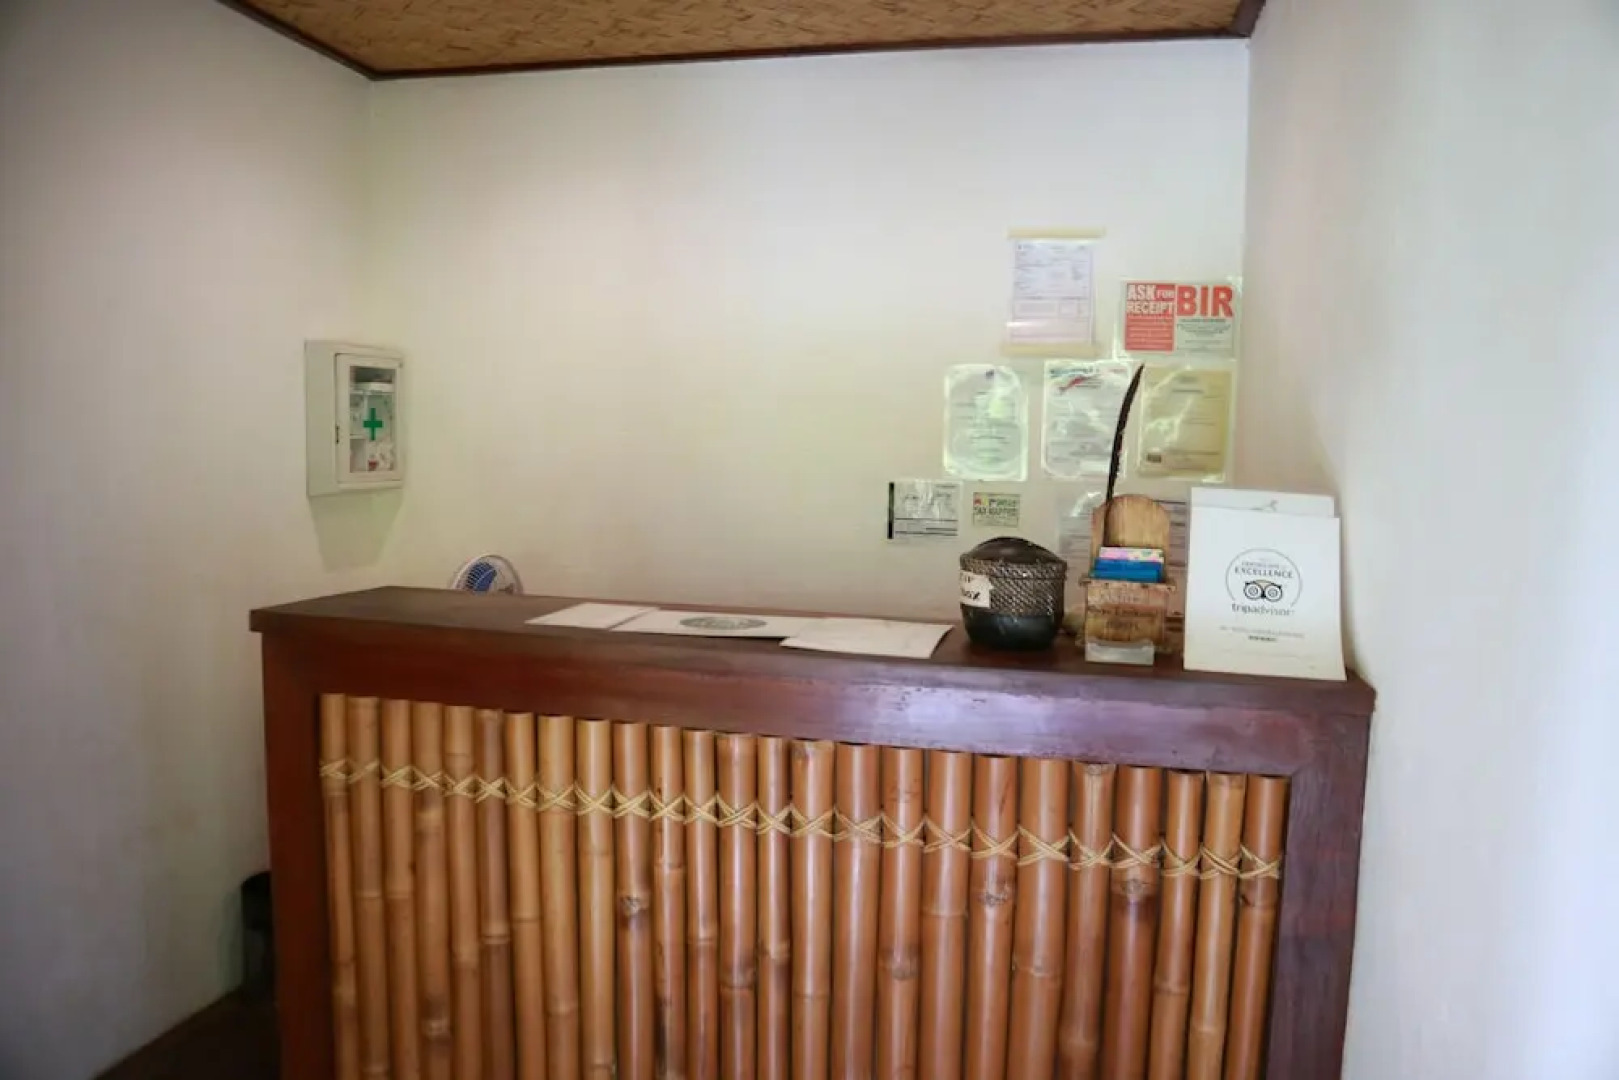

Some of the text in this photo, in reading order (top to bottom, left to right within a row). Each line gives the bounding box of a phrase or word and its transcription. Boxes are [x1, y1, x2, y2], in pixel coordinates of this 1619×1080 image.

[1127, 284, 1175, 300] ASK FOR
[1126, 301, 1174, 315] RECEIPT
[1177, 285, 1233, 317] BIR
[1234, 565, 1293, 579] EXCELLENCE
[1231, 603, 1291, 617] tripadvisor
